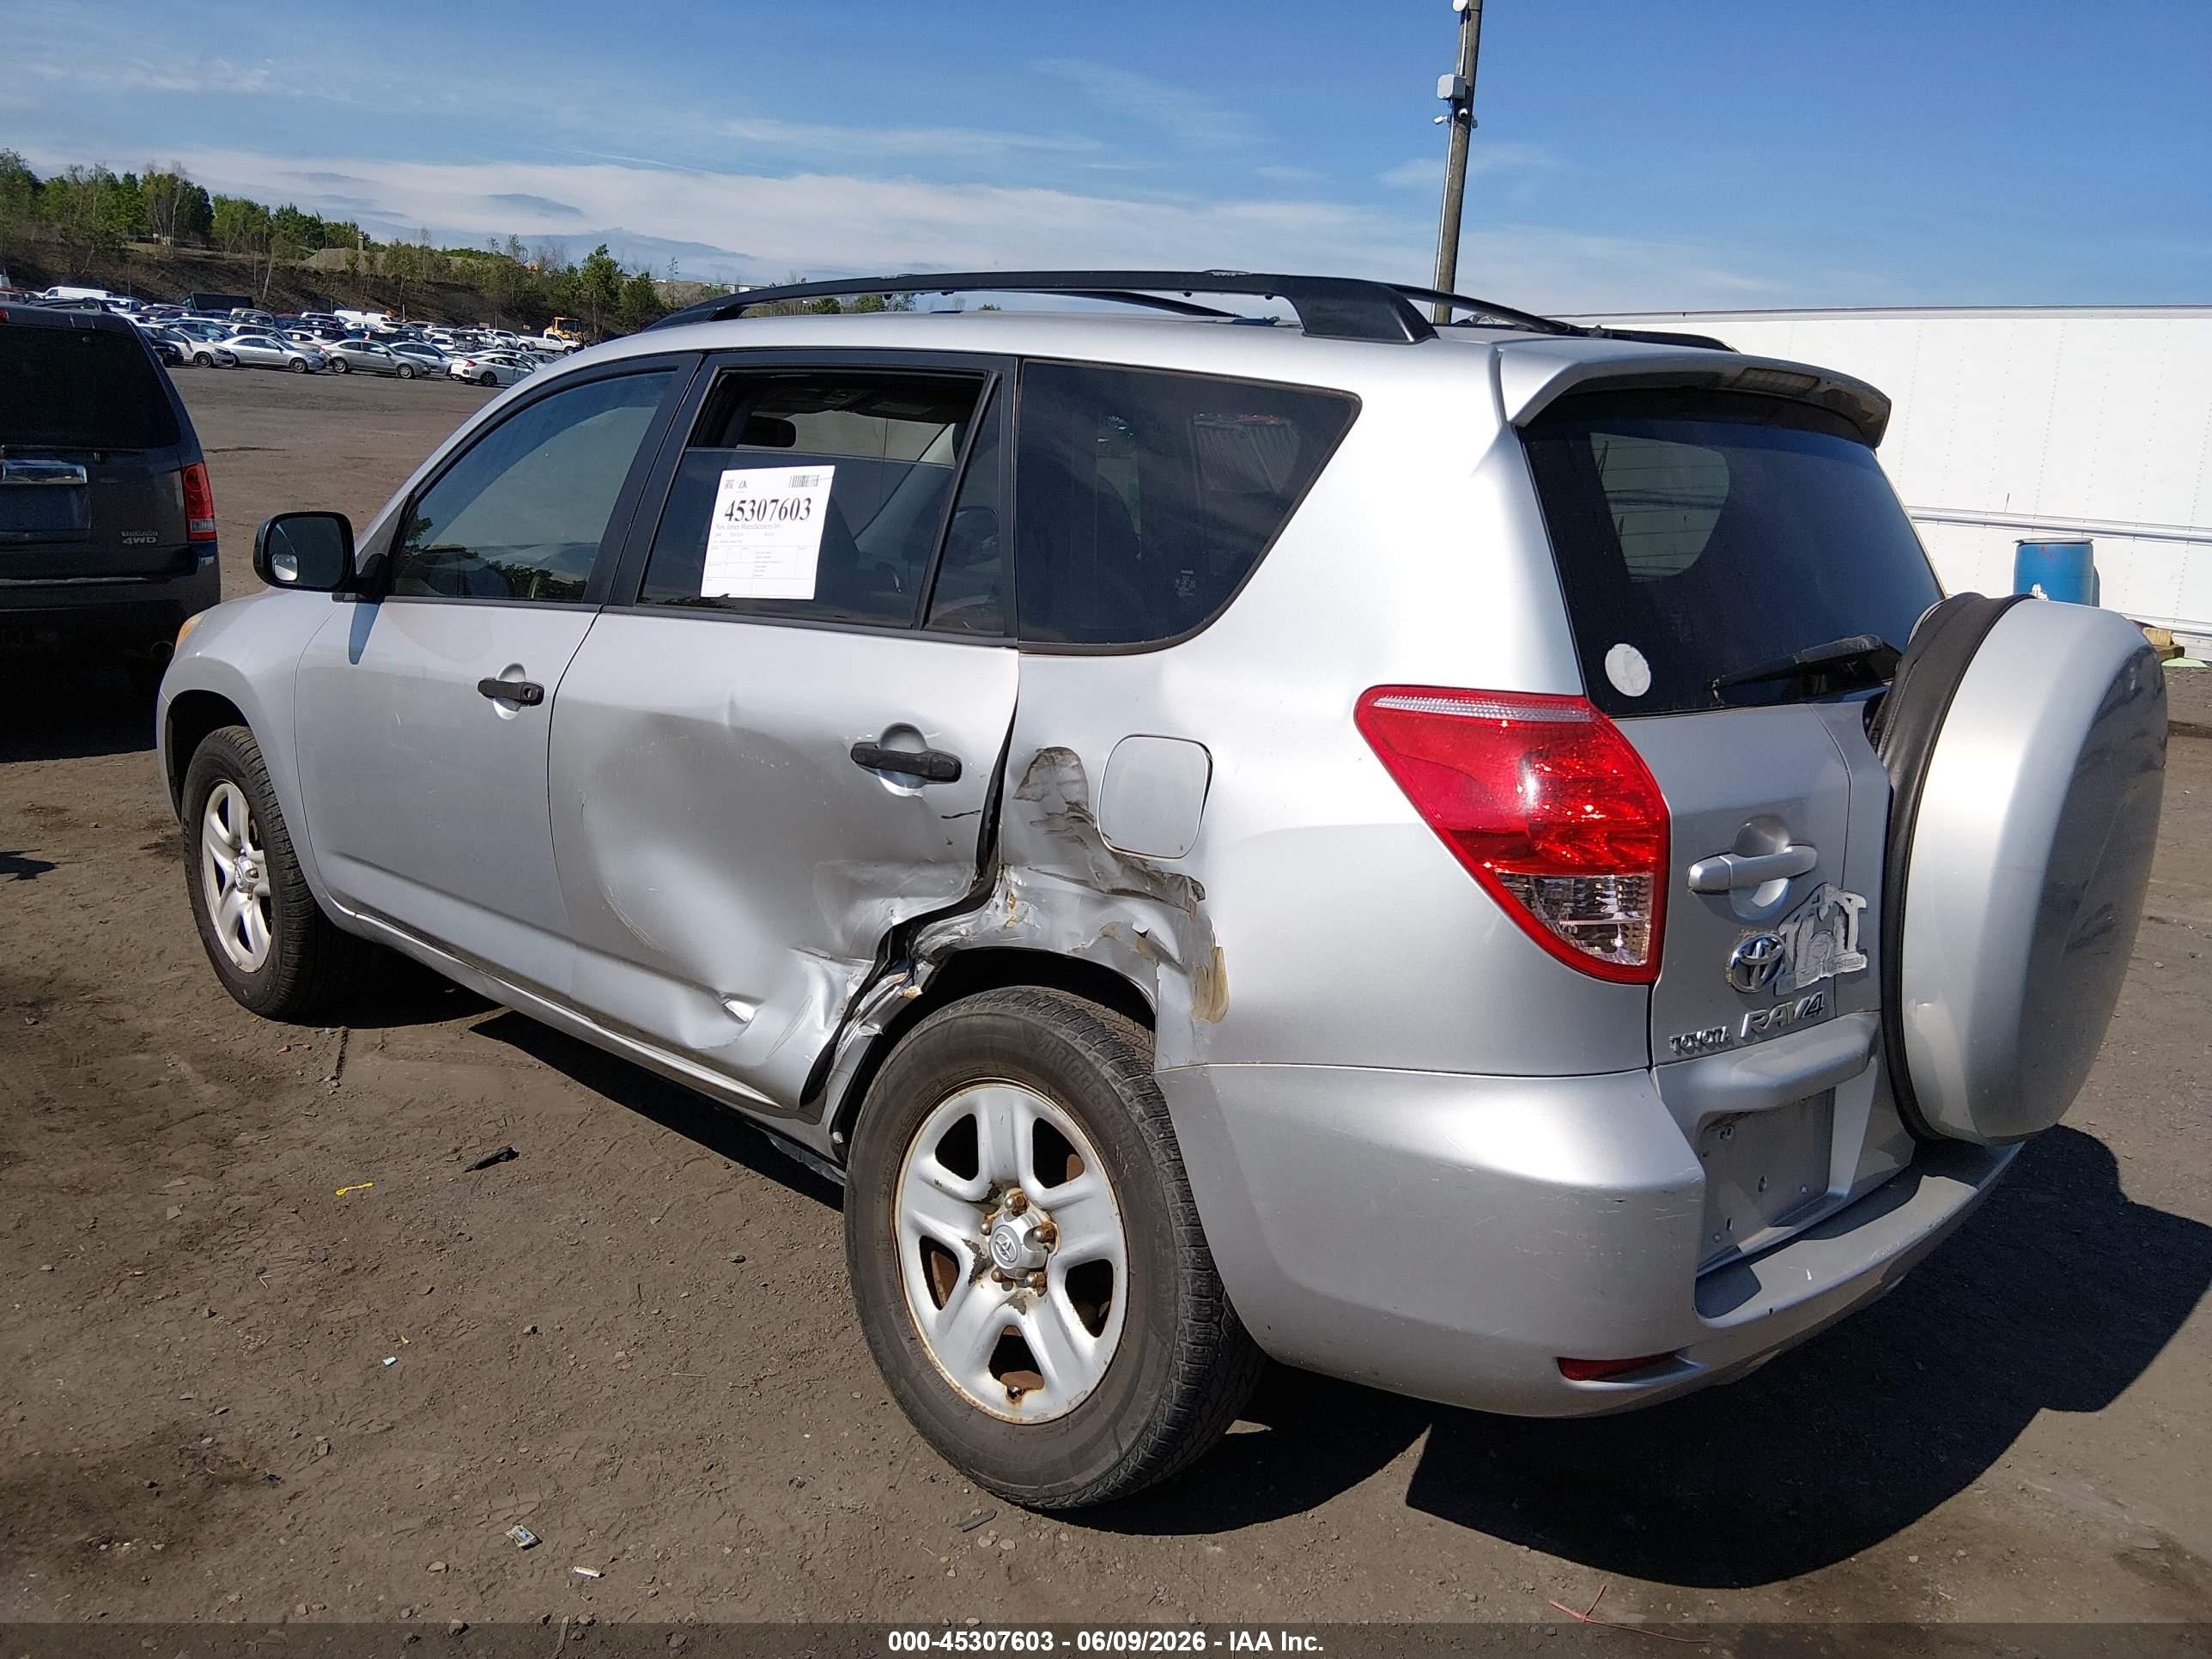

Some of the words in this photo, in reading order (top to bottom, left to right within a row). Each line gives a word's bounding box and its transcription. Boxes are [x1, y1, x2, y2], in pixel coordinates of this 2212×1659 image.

[724, 497, 812, 522] 45307603
[1741, 991, 1826, 1038] RAV4
[1669, 1026, 1731, 1054] TOYOTA
